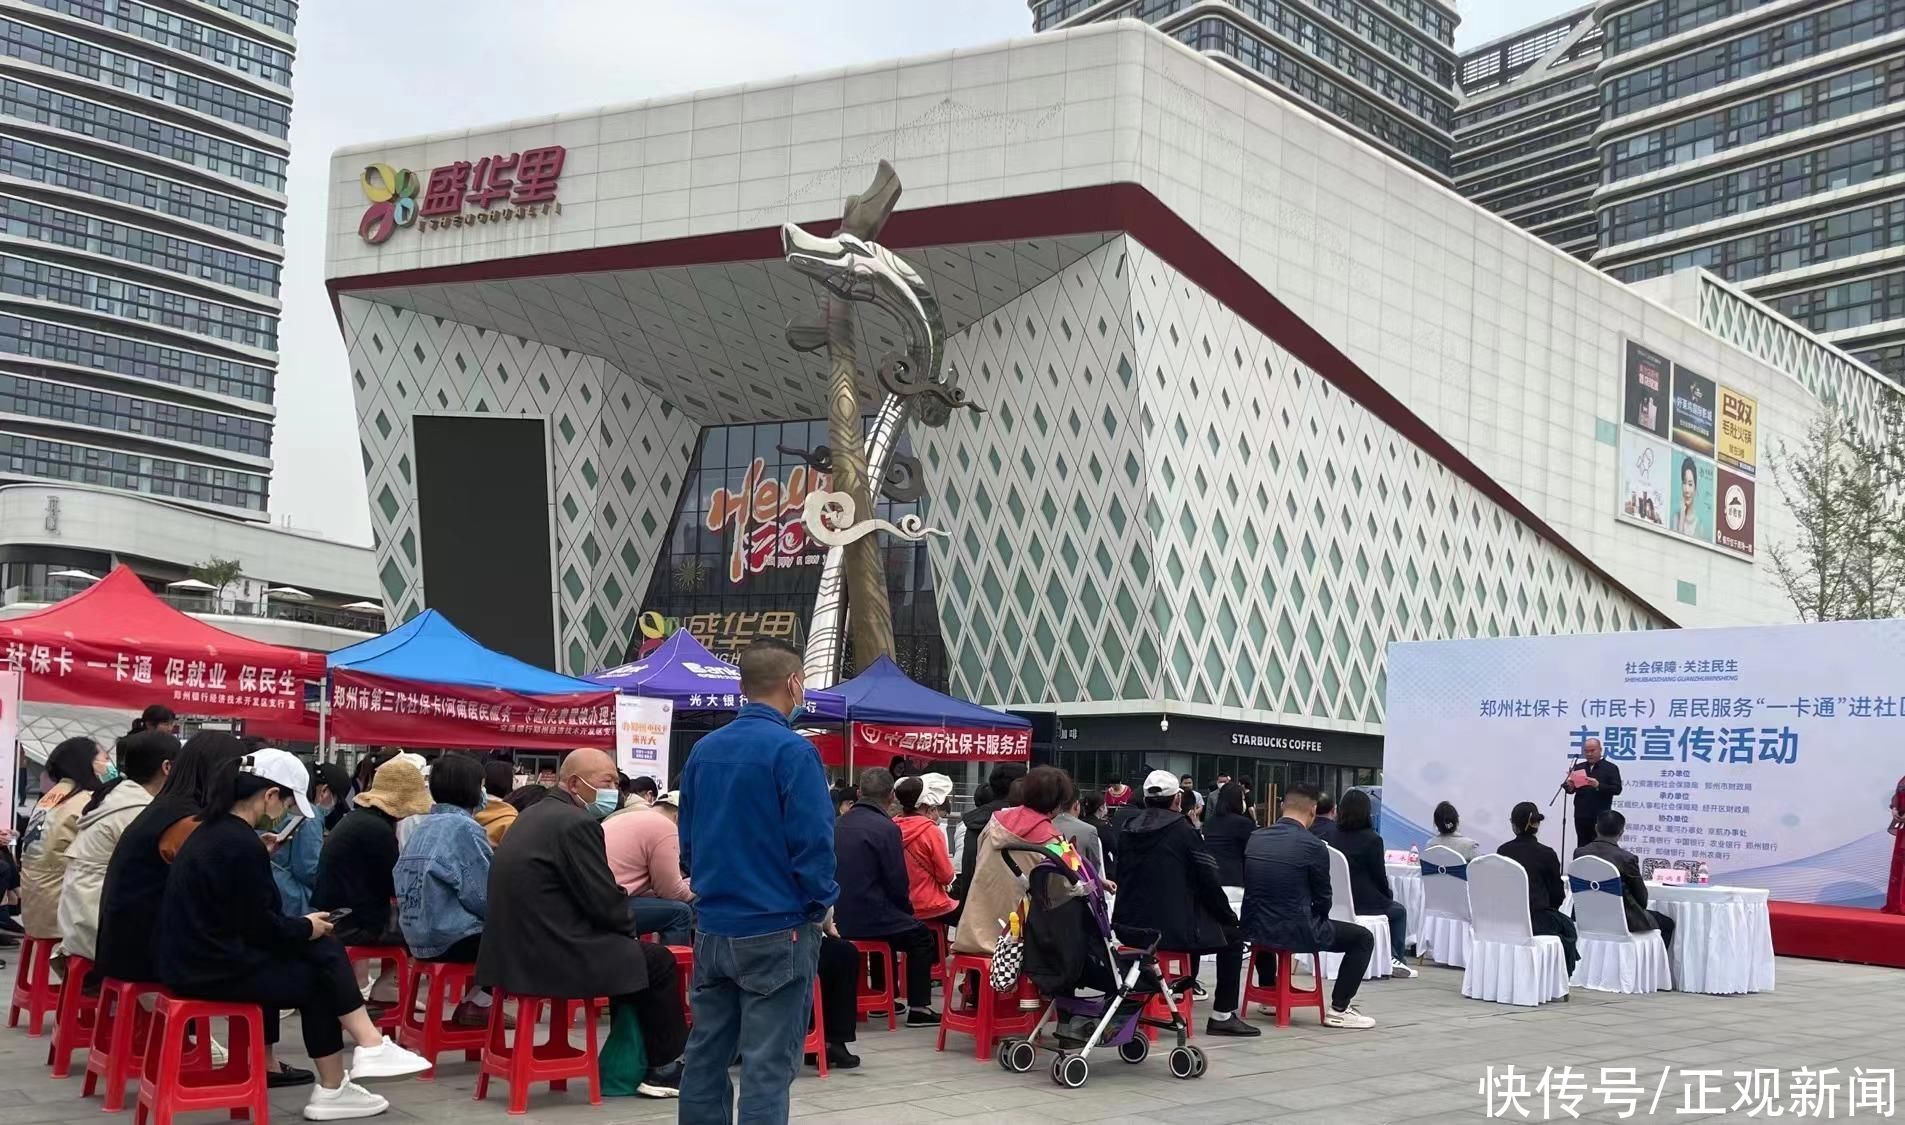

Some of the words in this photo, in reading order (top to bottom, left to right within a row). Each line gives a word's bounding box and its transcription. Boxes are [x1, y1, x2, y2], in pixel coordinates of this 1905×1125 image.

[420, 146, 566, 217] 盛华里
[1723, 393, 1752, 426] 巴奴
[6, 642, 74, 677] 社保卡
[87, 652, 153, 684] 一卡通
[164, 657, 227, 690] 促就业
[238, 664, 297, 696] 保民生
[884, 731, 1027, 756] 中国银行社保卡服务点
[1232, 733, 1287, 748] STARBUCKS
[1288, 739, 1322, 752] COFFEE
[1567, 725, 1799, 764] 主题宣传活动
[1660, 769, 1691, 778] 主办单位
